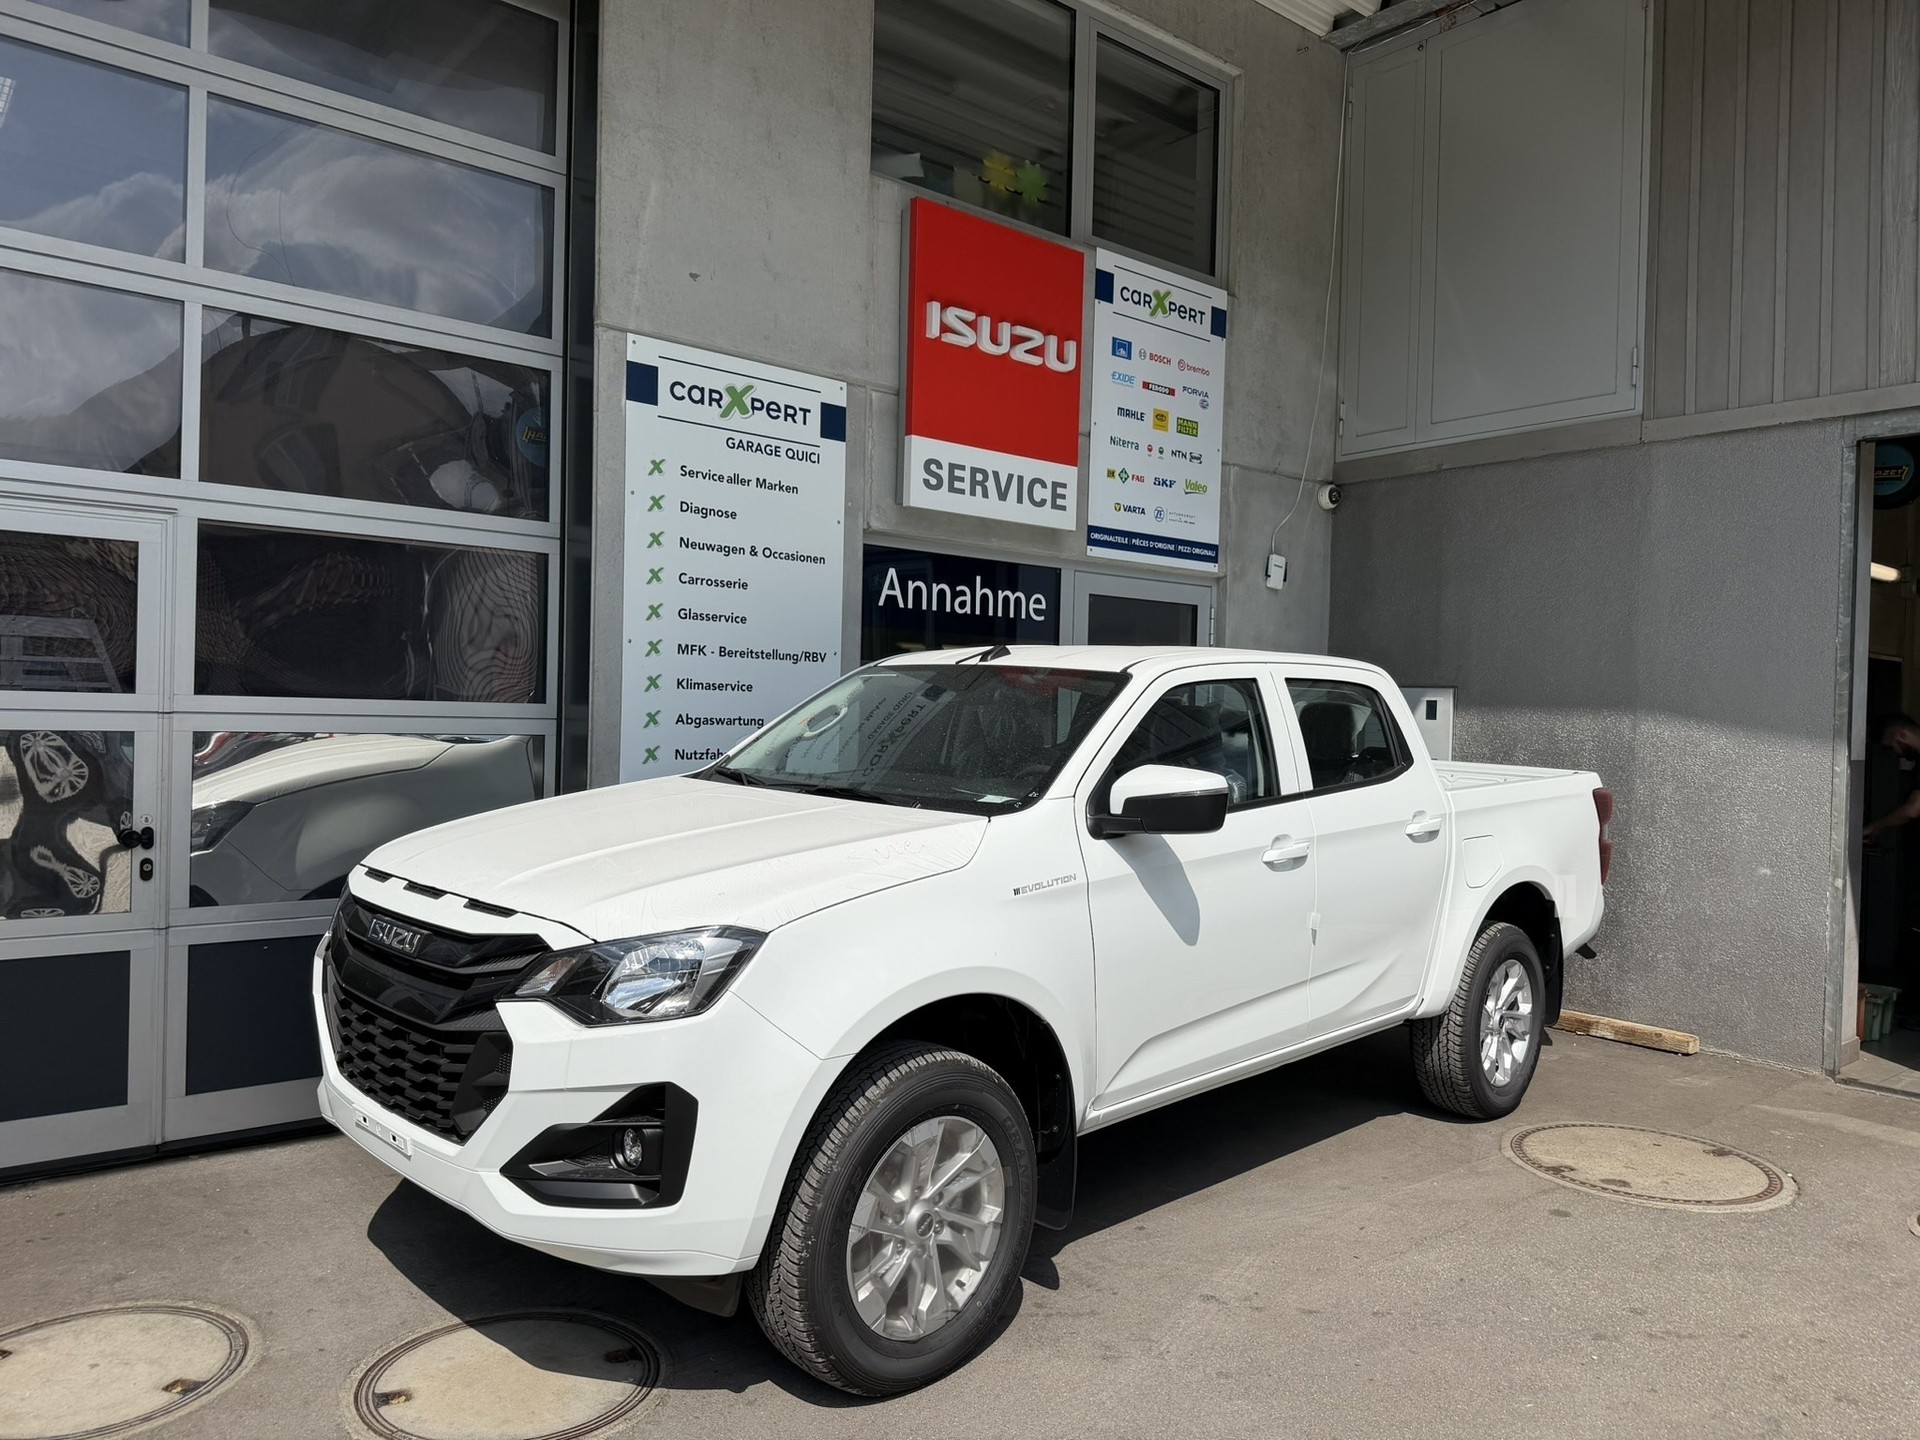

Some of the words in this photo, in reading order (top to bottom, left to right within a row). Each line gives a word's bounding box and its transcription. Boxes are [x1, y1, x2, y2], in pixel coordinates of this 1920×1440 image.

[925, 301, 1077, 373] ISUZU
[1149, 352, 1172, 366] BOSCH
[1111, 371, 1136, 384] EXIDE
[1187, 363, 1211, 376] brembo
[1182, 385, 1209, 399] FORVIA
[1117, 406, 1146, 421] MAHLE
[726, 437, 782, 458] GARAGE
[785, 447, 821, 465] QUICI
[1110, 435, 1140, 451] Niterra
[1171, 449, 1188, 460] NTN
[680, 465, 725, 483] Service
[726, 469, 752, 487] aller
[755, 477, 799, 494] Marken
[923, 457, 1068, 512] SERVICE
[1131, 474, 1145, 483] FAG
[1153, 476, 1176, 489] SKF
[1185, 479, 1208, 494] Valeo
[679, 501, 738, 520] Diagnose
[1123, 504, 1146, 515] VARTA
[679, 536, 746, 556] Neuwagen
[749, 545, 759, 557] &
[762, 547, 826, 565] Occasionen
[678, 572, 749, 590] Carrosserie
[878, 567, 1047, 621] Annahme
[677, 608, 747, 624] Glasservice
[677, 643, 707, 657] MFK
[718, 646, 827, 664] Bereitstellung/RBV
[676, 677, 753, 692] Klimaservice
[675, 713, 765, 728] Abgaswartung
[1020, 873, 1077, 895] EVOLUTION
[368, 918, 421, 954] ISUZU
